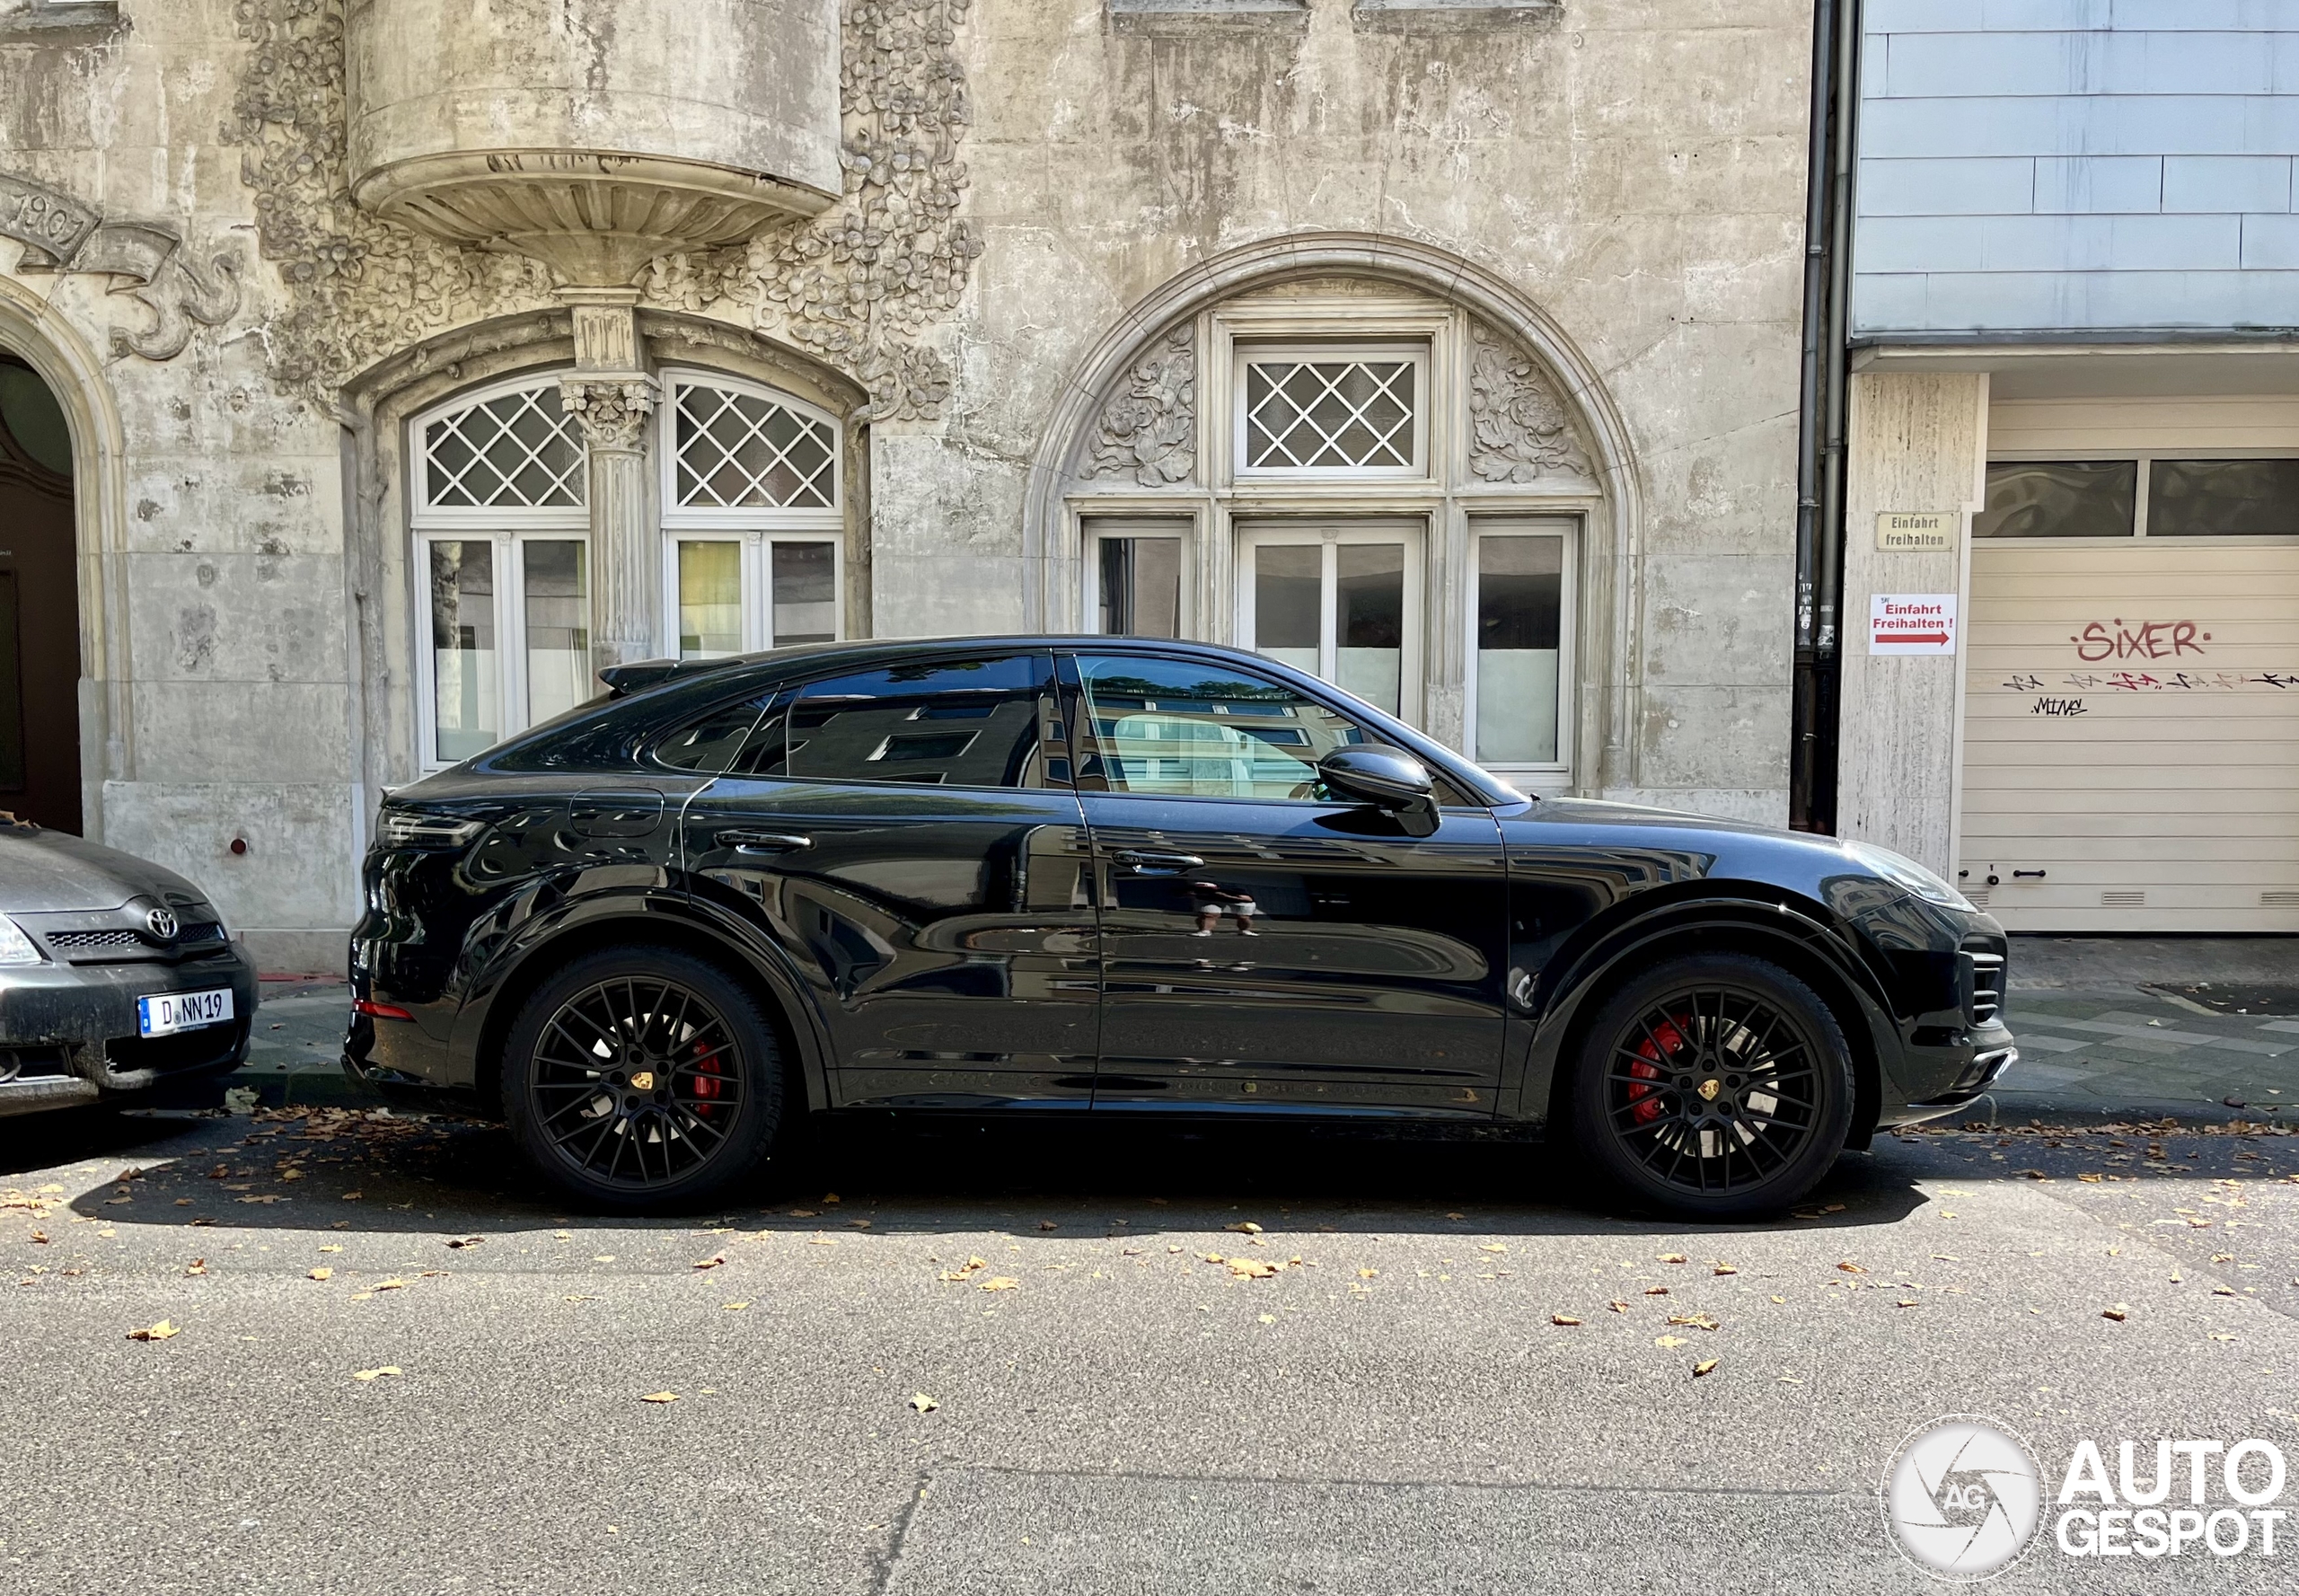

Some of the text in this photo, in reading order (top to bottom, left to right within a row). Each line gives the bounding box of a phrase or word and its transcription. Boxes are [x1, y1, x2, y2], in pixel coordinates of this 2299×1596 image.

[1891, 516, 1939, 529] Einfahrt
[1886, 533, 1944, 546] freihalten
[1885, 604, 1942, 614] Einfahrt
[1872, 618, 1944, 629] Freihalten
[162, 1001, 172, 1025] D
